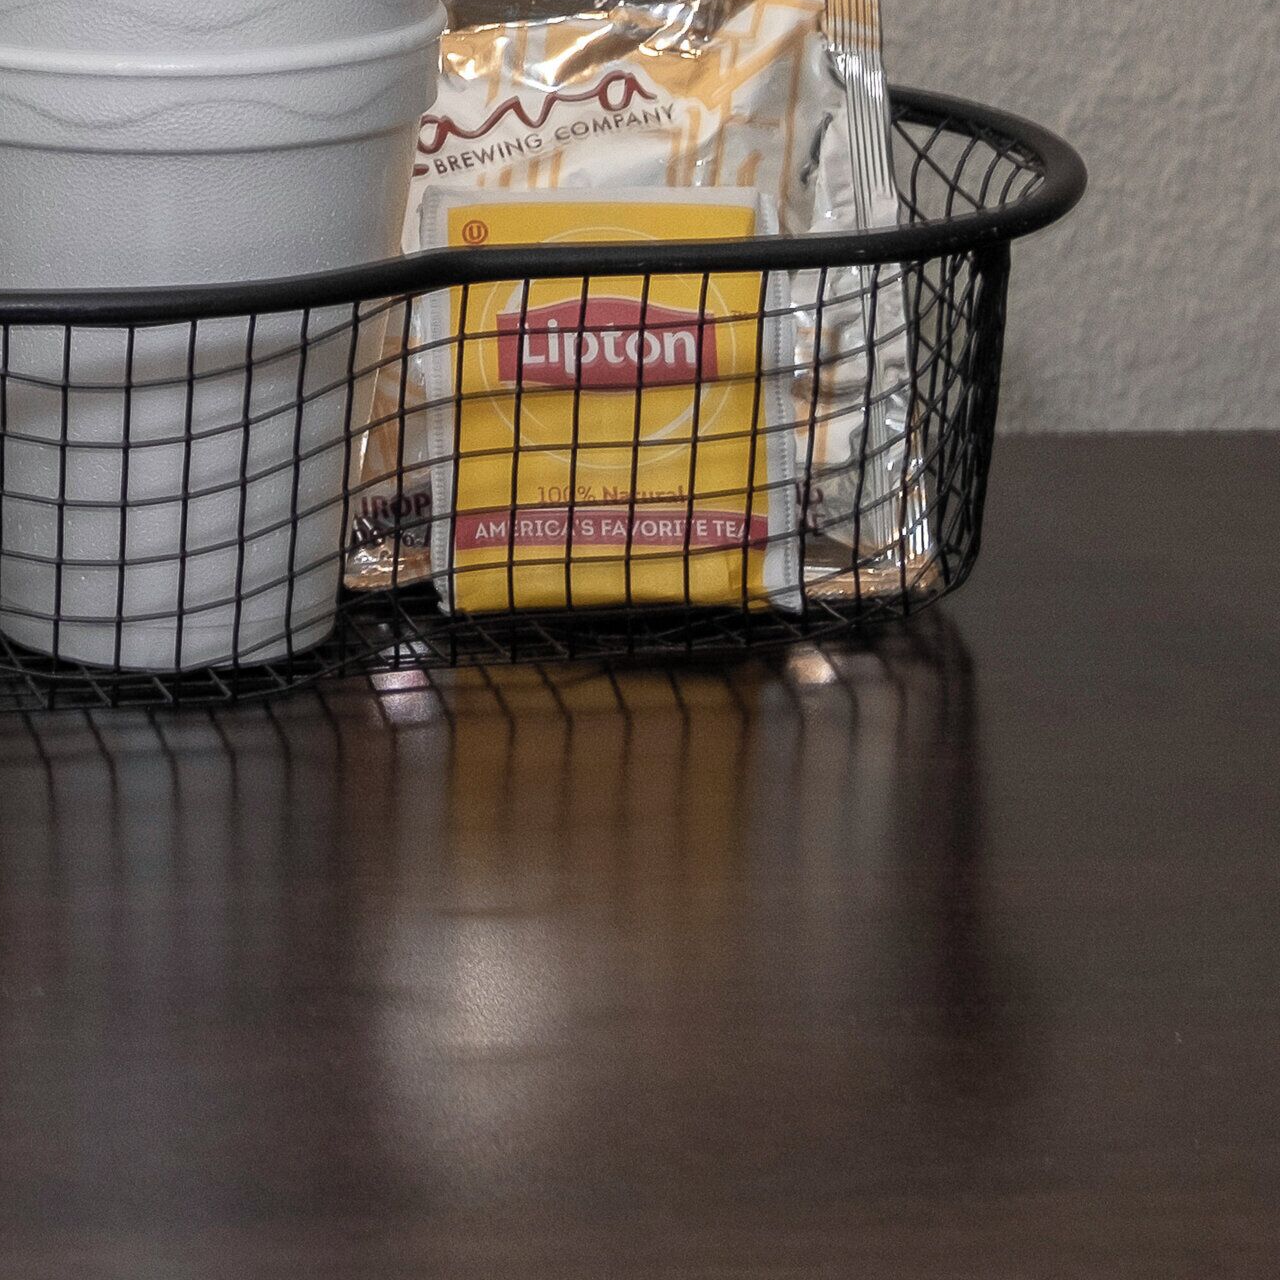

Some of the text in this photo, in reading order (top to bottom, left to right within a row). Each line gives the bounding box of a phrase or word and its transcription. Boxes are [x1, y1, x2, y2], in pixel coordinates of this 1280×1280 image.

[417, 70, 658, 154] ava
[434, 103, 675, 176] BREWING COMPANY
[517, 318, 698, 376] Lipton
